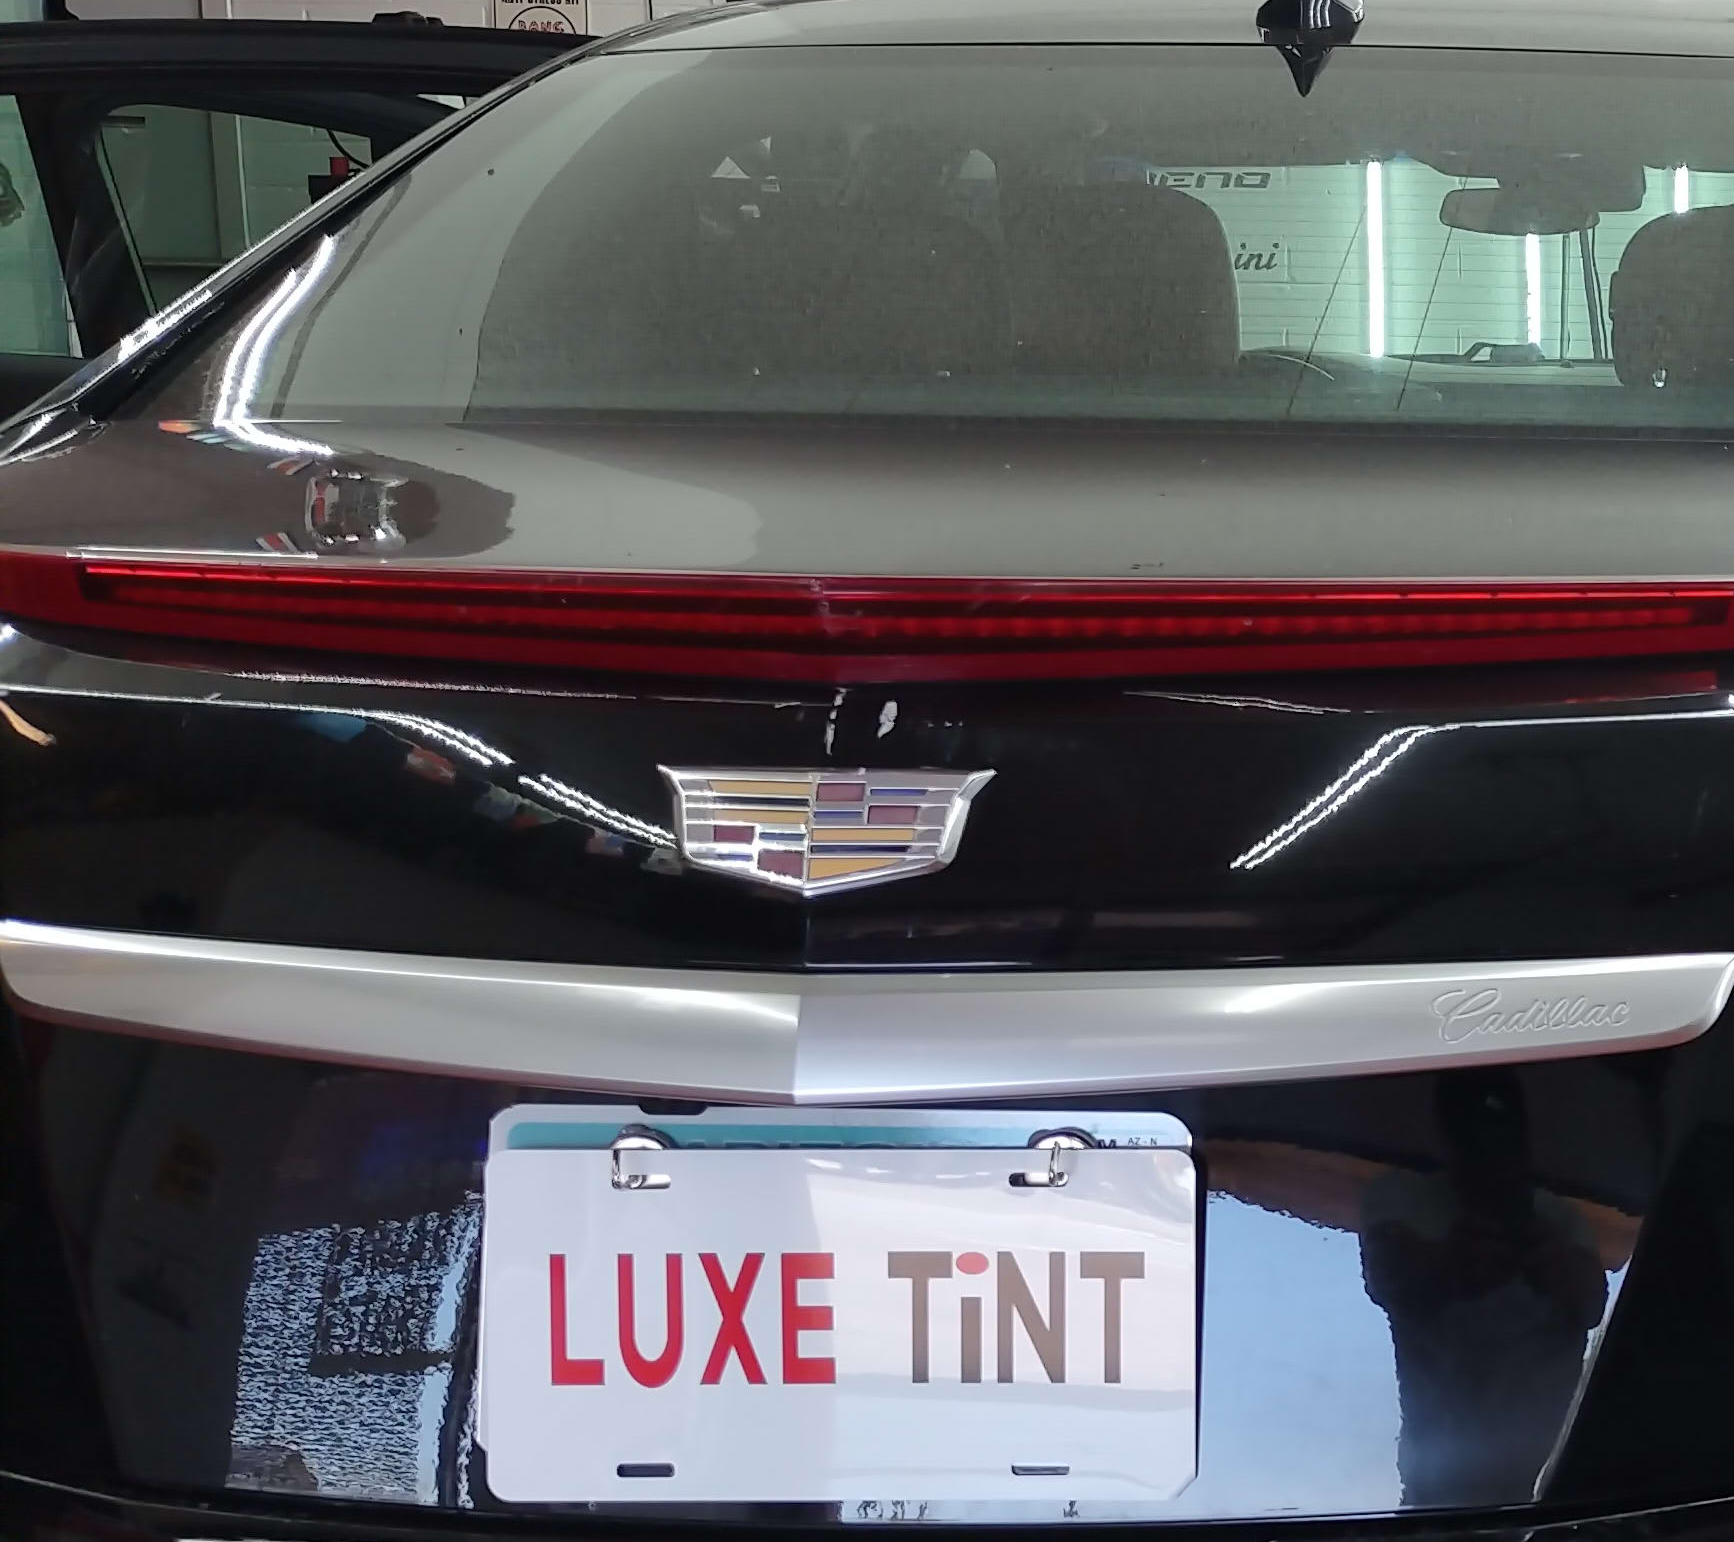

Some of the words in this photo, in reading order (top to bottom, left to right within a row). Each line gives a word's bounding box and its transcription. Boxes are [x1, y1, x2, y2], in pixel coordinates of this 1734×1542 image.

[1234, 242, 1280, 270] ini
[1430, 988, 1630, 1044] Cadillac
[549, 1252, 837, 1388] LUXE
[887, 1250, 1146, 1384] TiNT
